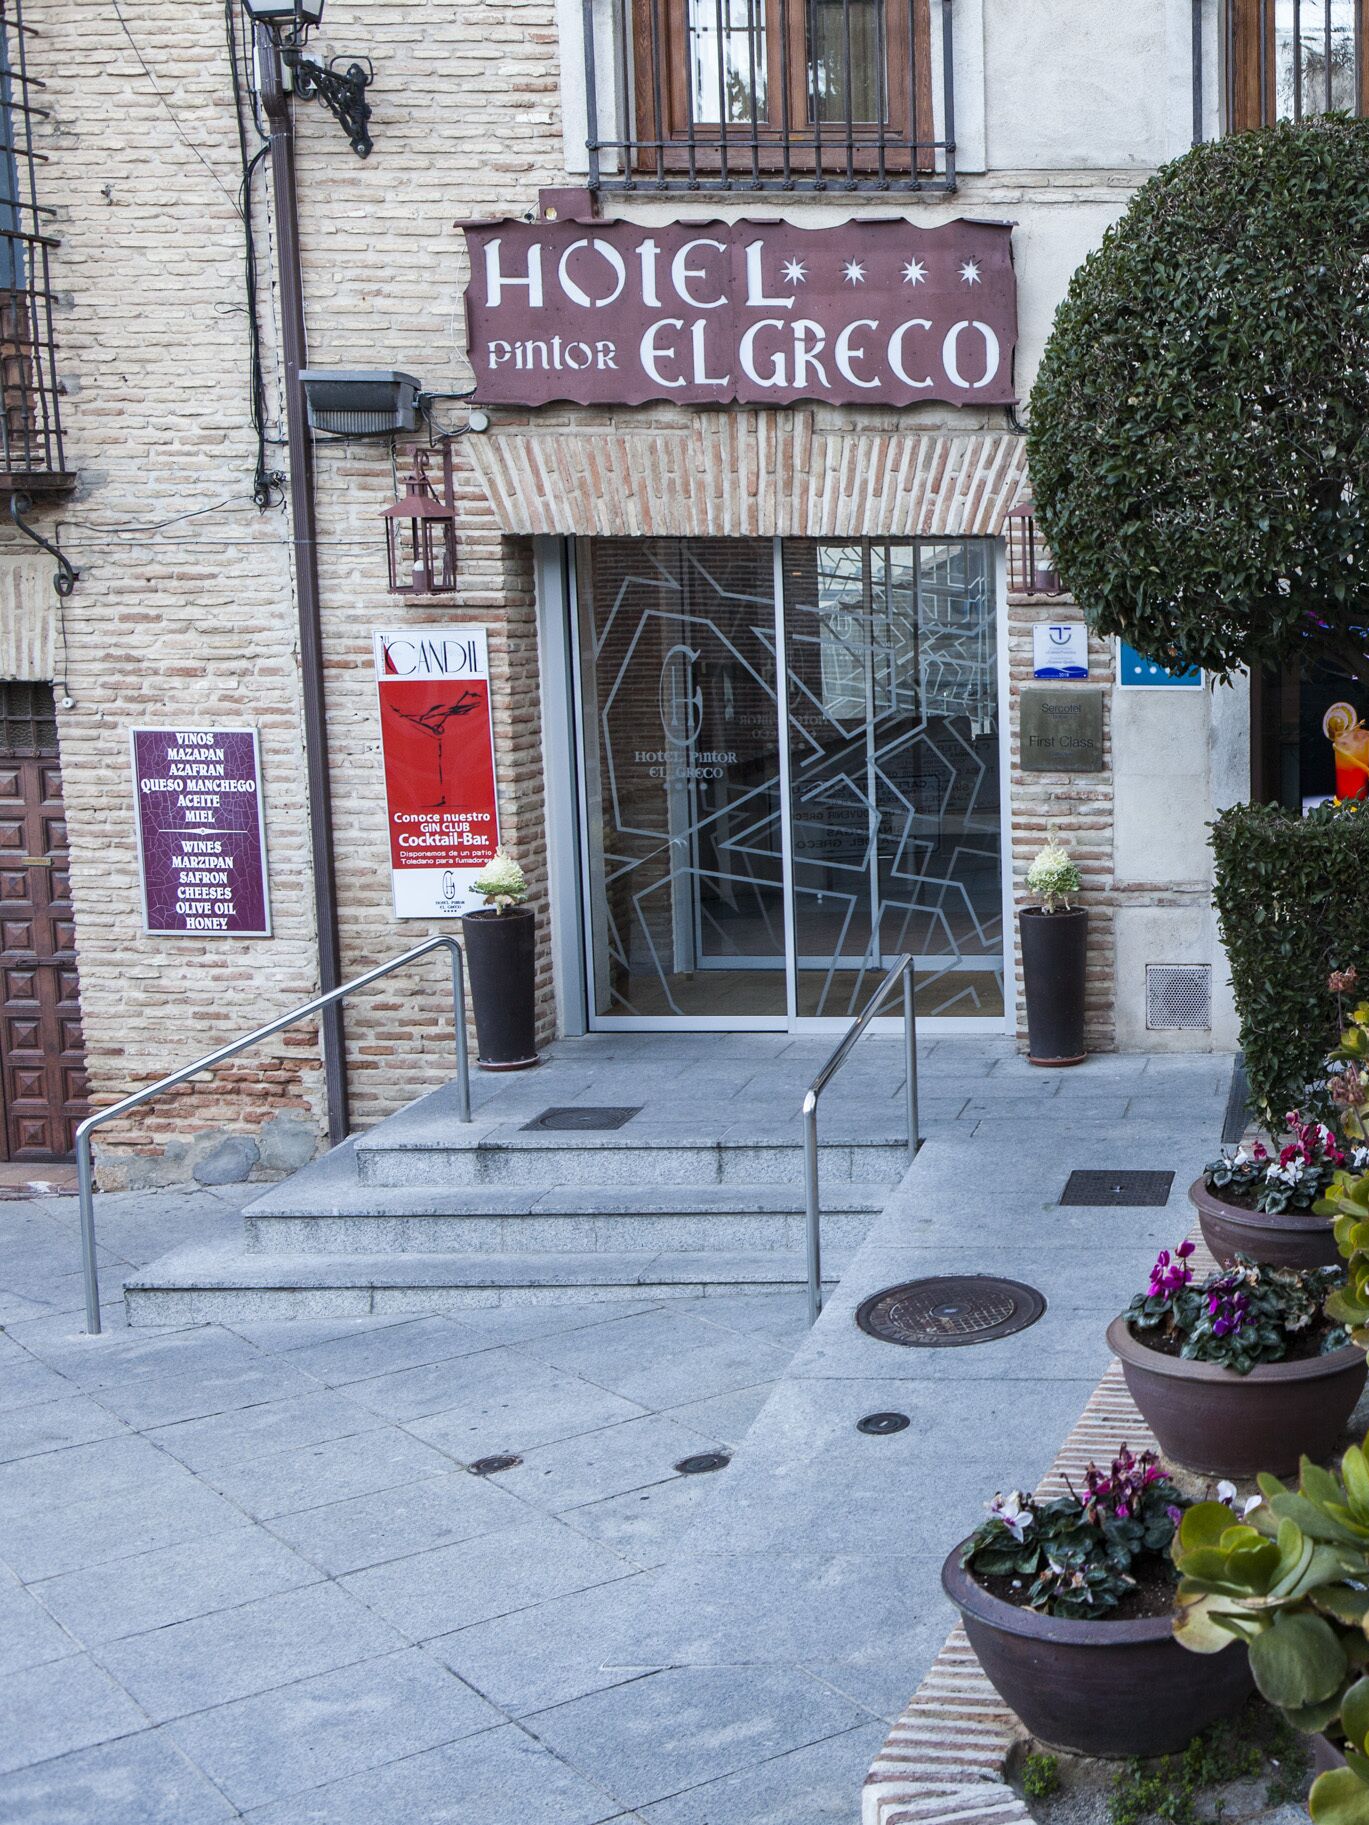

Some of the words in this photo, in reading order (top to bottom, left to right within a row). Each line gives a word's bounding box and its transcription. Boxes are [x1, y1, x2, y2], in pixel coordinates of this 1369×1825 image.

[484, 239, 795, 308] HOTEL
[1042, 703, 1081, 713] Sercotel
[176, 733, 214, 745] VINOS
[1029, 736, 1054, 747] First
[1060, 735, 1093, 748] Class
[168, 749, 224, 760] MAZAPAN
[169, 764, 224, 776] AZAFRAN
[676, 768, 724, 778] GRECO
[141, 779, 183, 793] QUESO
[187, 780, 255, 792] MANCHEGO
[178, 795, 220, 807] ACEITE
[185, 811, 215, 822] MIEL
[394, 813, 440, 822] Conoce
[444, 813, 490, 821] nuestro
[420, 824, 439, 832] GIN
[442, 823, 470, 831] CLUB
[399, 833, 489, 846] Cocktail-Bar.
[182, 841, 221, 853] WINES
[172, 857, 233, 868] MARZIPAN
[180, 872, 227, 883] SAFRON
[178, 887, 232, 899] CHEESES
[176, 903, 211, 914] OLIVE
[214, 903, 235, 914] OIL
[186, 918, 227, 929] HONEY
